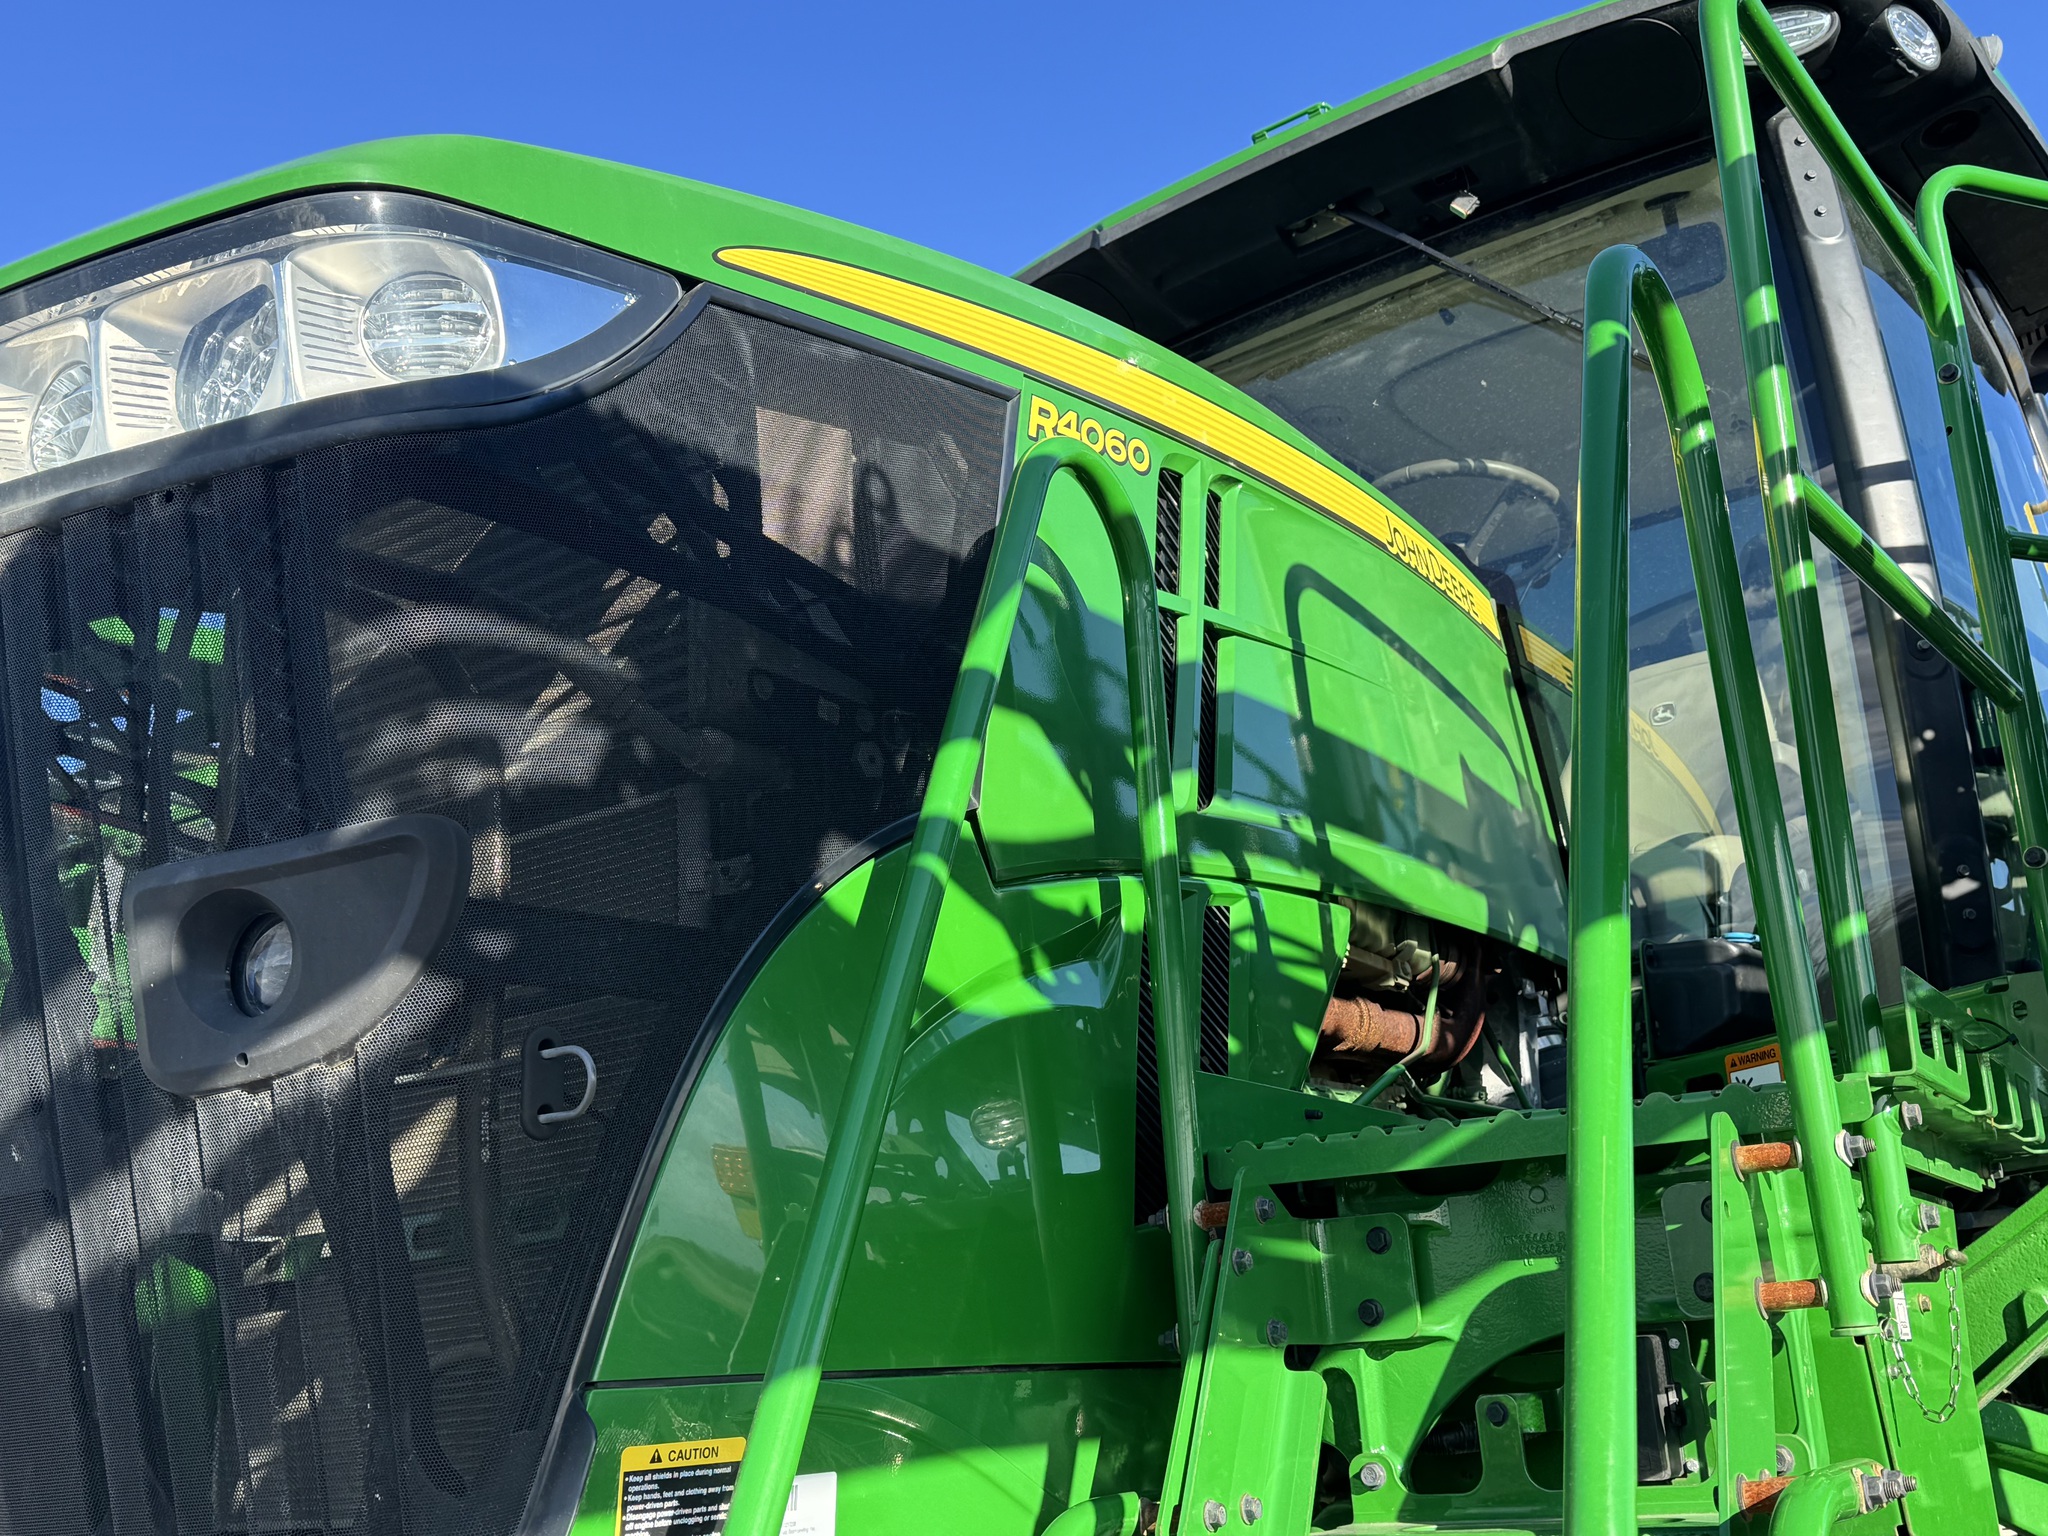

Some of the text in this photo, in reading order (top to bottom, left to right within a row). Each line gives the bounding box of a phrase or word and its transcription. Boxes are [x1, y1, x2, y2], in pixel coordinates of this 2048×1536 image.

[1028, 394, 1151, 476] R4060
[1738, 1048, 1776, 1065] WARNING
[668, 1446, 719, 1462] CAUTION
[628, 1475, 643, 1483] Keep
[652, 1471, 672, 1480] shields
[680, 1470, 694, 1479] place
[714, 1466, 731, 1474] normal
[628, 1483, 659, 1493] operations.
[628, 1494, 642, 1502] Keep
[643, 1492, 662, 1500] hands,
[662, 1490, 673, 1498] feet
[674, 1489, 684, 1497] and
[686, 1487, 707, 1495] clothing
[708, 1486, 721, 1494] away
[626, 1512, 656, 1521] Disengage
[656, 1507, 692, 1519] power-driven
[693, 1506, 706, 1515] parts
[627, 1499, 680, 1512] power-driven parts.
[673, 1516, 703, 1525] unclogging
